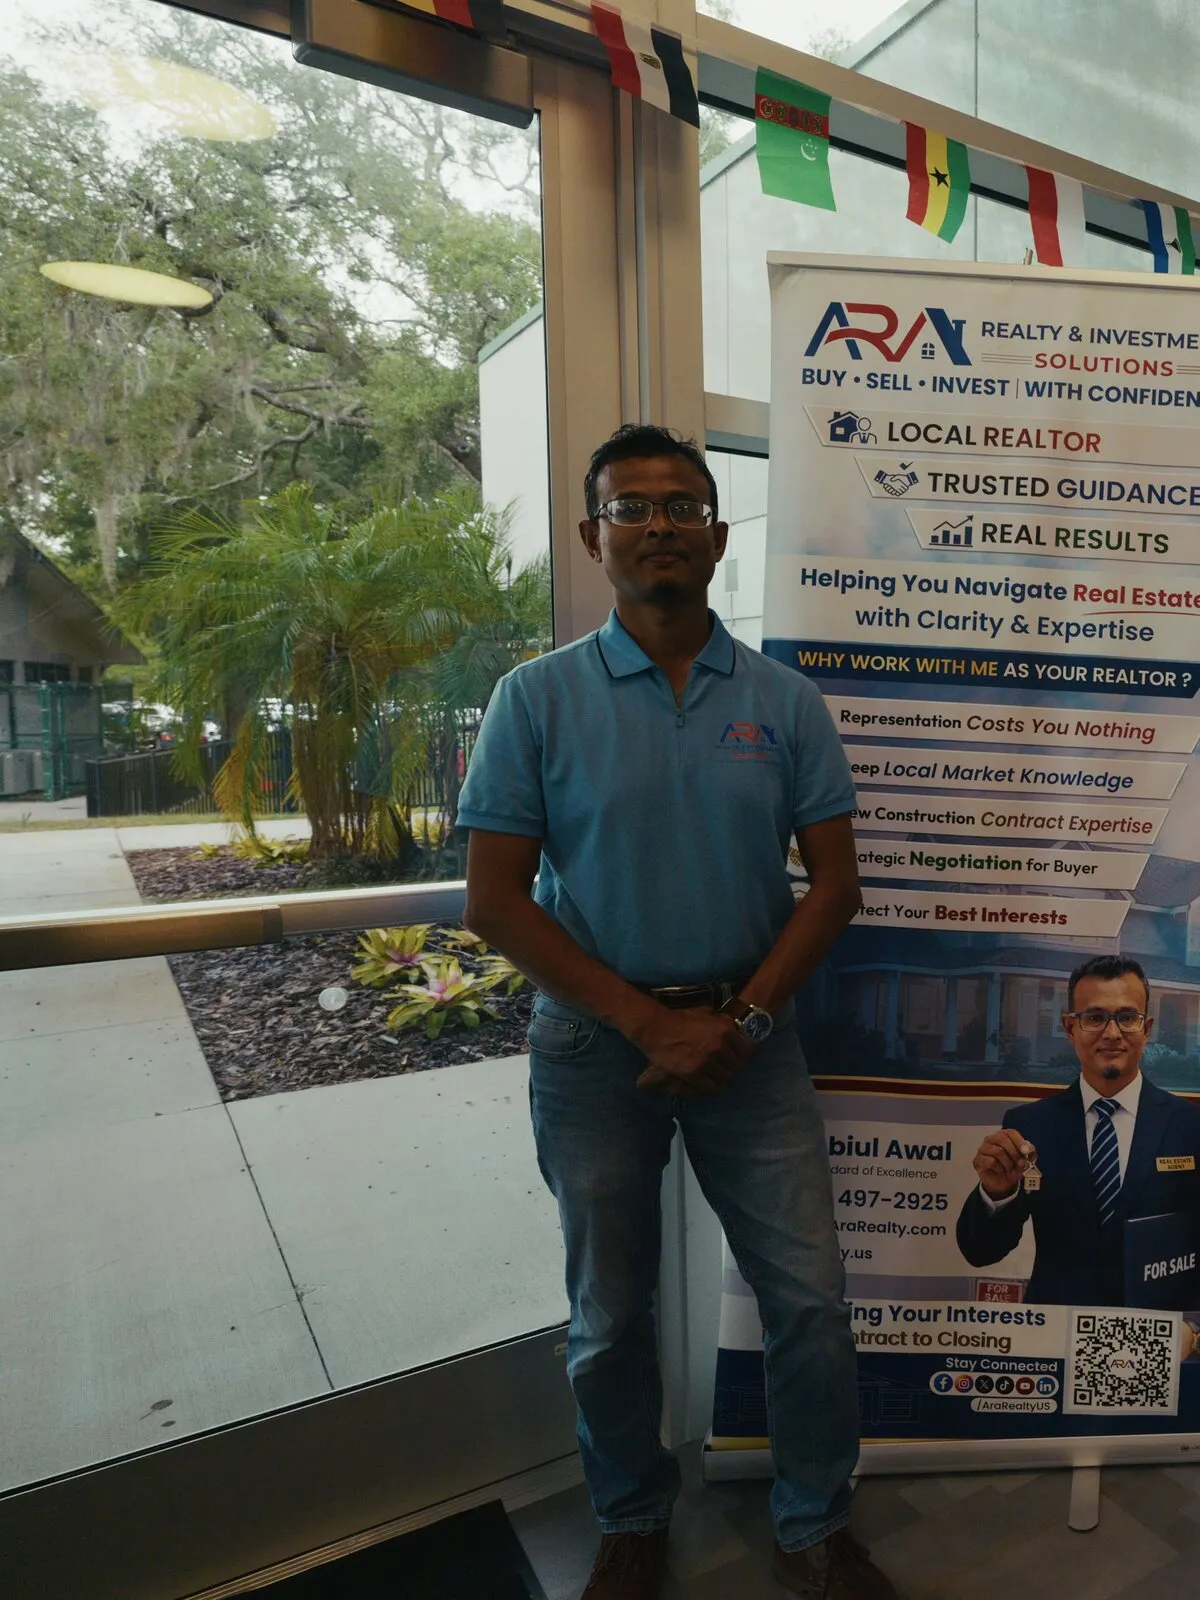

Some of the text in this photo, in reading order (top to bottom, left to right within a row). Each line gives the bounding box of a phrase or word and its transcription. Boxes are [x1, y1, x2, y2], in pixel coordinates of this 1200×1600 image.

[982, 321, 1063, 342] REALTY
[1068, 326, 1082, 342] &
[1034, 353, 1174, 377] SOLUTIONS
[801, 368, 847, 387] BUY
[866, 373, 912, 391] SELL
[932, 376, 1009, 397] INVEST
[1025, 380, 1082, 401] WITH
[887, 421, 1101, 453] LOCAL REALTOR
[927, 472, 1049, 497] TRUSTED
[982, 523, 1169, 554] REAL RESULTS
[800, 568, 896, 595] Helping
[902, 574, 949, 594] You
[954, 577, 1067, 603] Navigate
[1073, 584, 1125, 604] Real
[856, 608, 1154, 643] with Clarity & Expertise
[798, 651, 1191, 688] WHY WORK WITH ME AS YOUR REALTOR ?
[840, 710, 1156, 745] Representation Costs You Nothing
[850, 760, 1134, 791] eep Local Market Knowledge
[849, 806, 1153, 836] ew Construction Contract Expertise
[856, 851, 1098, 877] ategic Negotiation for Buyer
[859, 904, 1068, 925] tect Your Best Interests
[829, 1136, 952, 1161] biul Awal
[831, 1164, 937, 1179] dard of Excellence
[1144, 1253, 1196, 1282] FOR SALE
[985, 1293, 1010, 1302] SALE
[987, 1284, 1008, 1293] FOR
[889, 1305, 942, 1322] Your
[947, 1306, 1045, 1327] Interests
[852, 1330, 1011, 1353] ntract to Closing
[946, 1357, 1058, 1373] Stay Connected
[976, 1399, 1051, 1413] /AraRealtyUS
